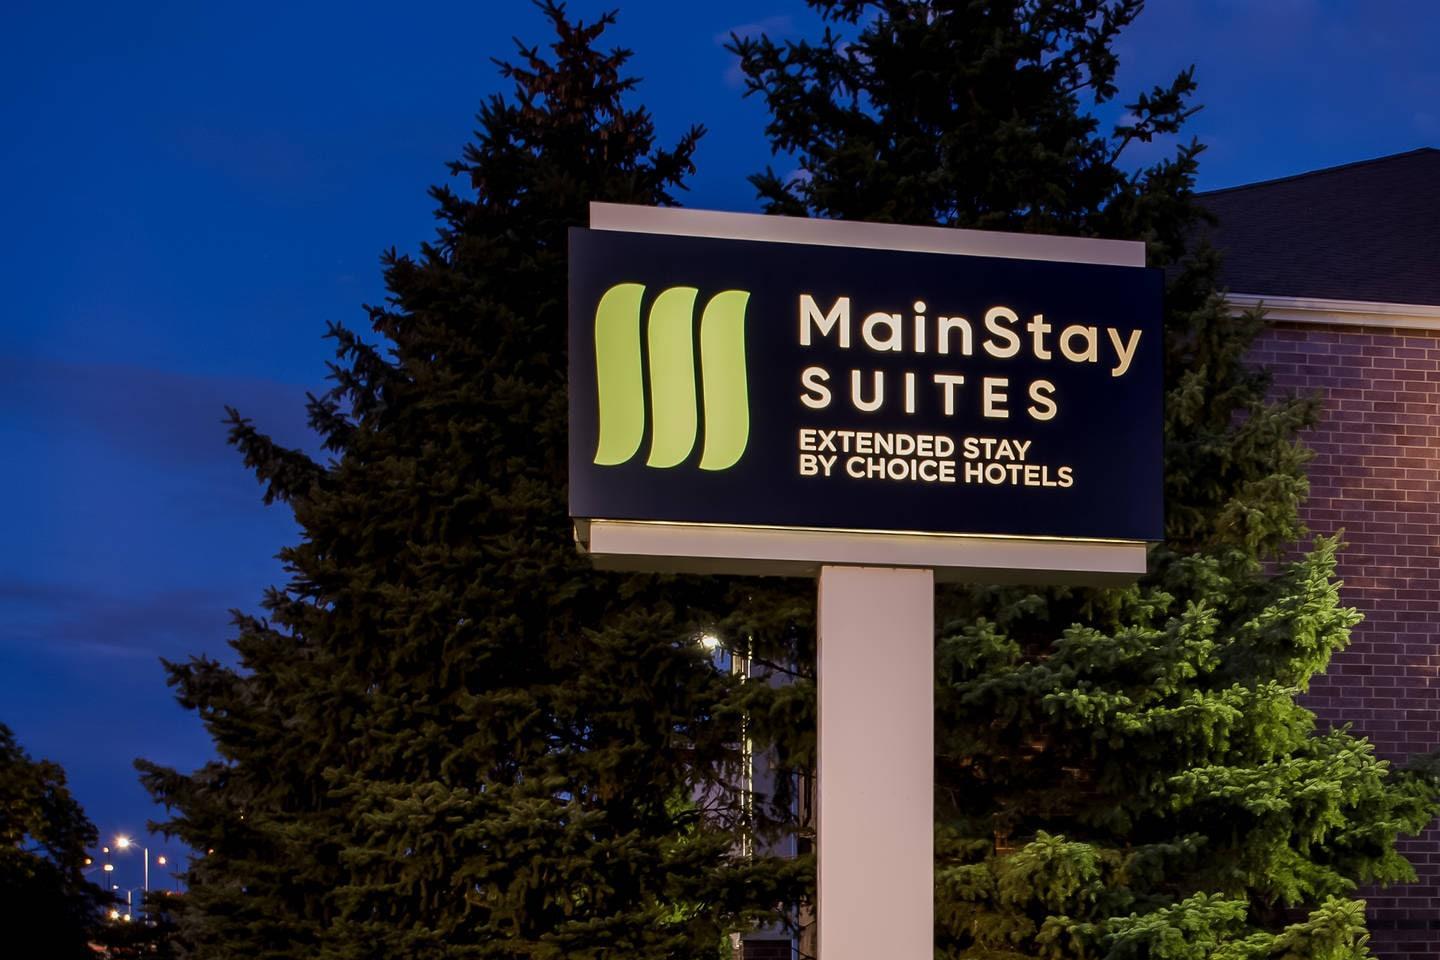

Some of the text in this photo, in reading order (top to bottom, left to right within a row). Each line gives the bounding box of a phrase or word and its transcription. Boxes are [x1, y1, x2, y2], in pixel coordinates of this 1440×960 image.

[799, 293, 1143, 377] MainStay
[800, 366, 1058, 421] SUITES
[799, 428, 1032, 461] EXTENDED STAY
[799, 453, 1074, 488] BY CHOICE HOTELS
